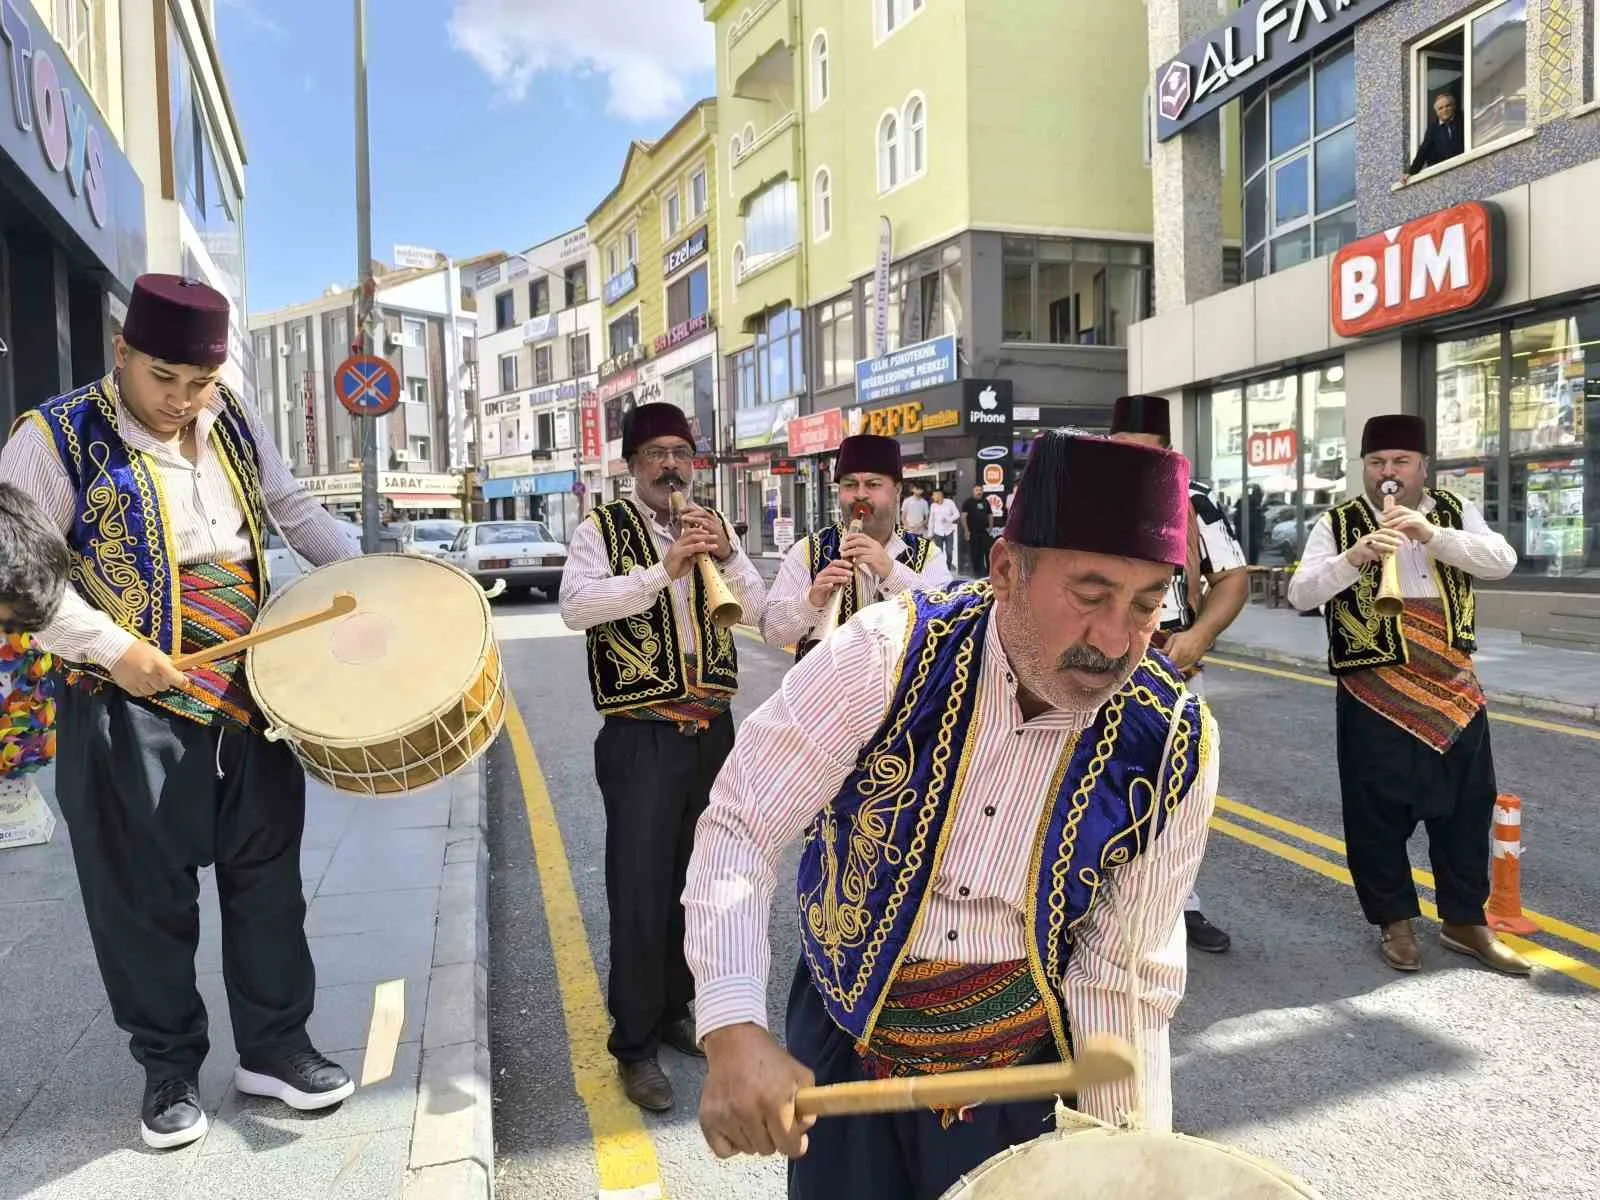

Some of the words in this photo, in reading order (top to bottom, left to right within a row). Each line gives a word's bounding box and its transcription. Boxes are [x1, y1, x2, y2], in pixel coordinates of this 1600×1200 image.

[1193, 0, 1358, 103] ALFA
[0, 0, 106, 230] TOYS
[1339, 223, 1470, 321] BİM
[970, 410, 1006, 424] iPhone
[1251, 432, 1293, 464] BİM
[384, 476, 422, 489] SARAY
